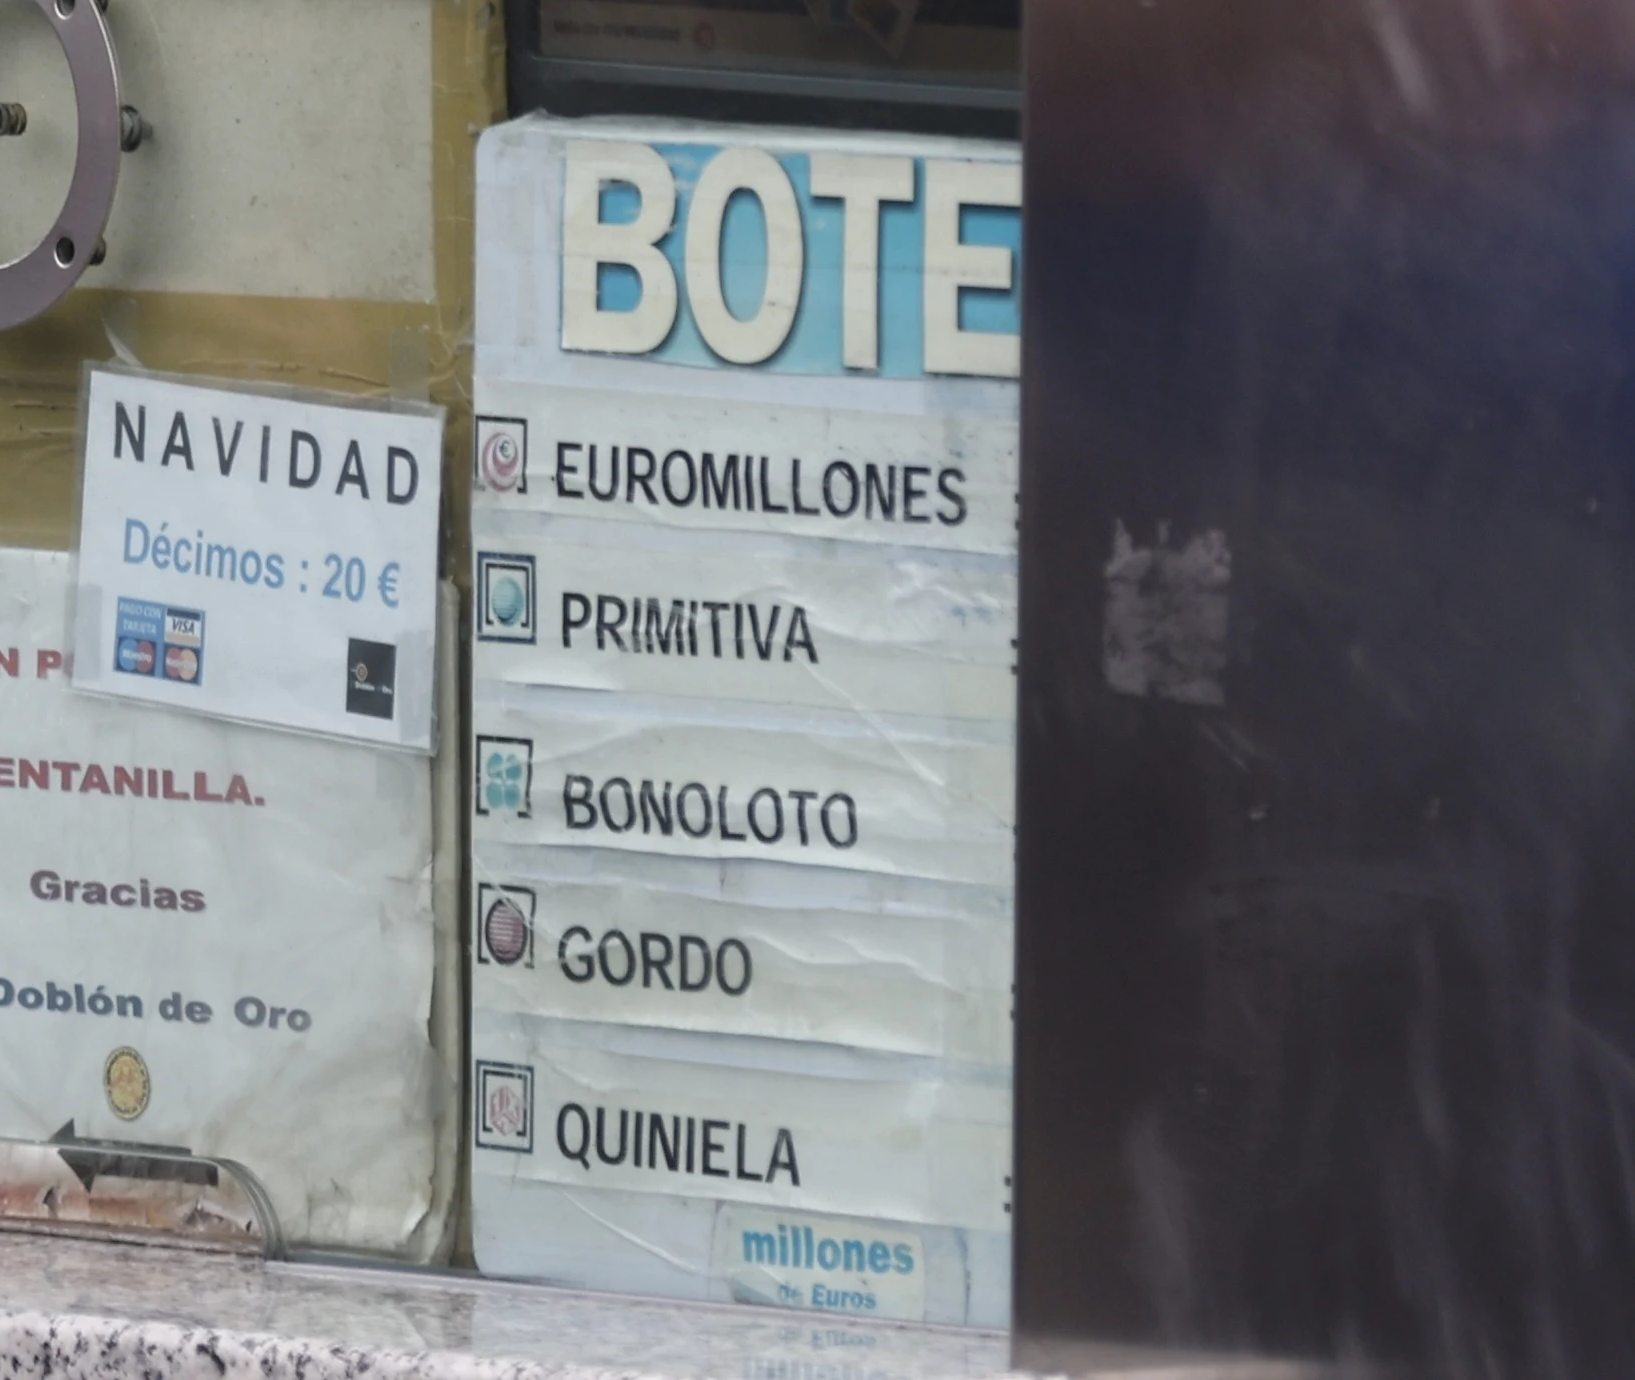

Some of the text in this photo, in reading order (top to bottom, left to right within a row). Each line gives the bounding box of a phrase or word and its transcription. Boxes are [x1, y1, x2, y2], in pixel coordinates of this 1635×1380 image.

[561, 139, 1023, 379] BOTE
[112, 400, 421, 507] NAVIDAD
[553, 441, 969, 528] EUROMILLONES
[122, 516, 284, 590] Décimos
[321, 551, 366, 601] 20
[377, 560, 402, 608] €
[172, 618, 195, 636] VISA
[561, 591, 821, 665] PRIMITIVA
[36, 649, 63, 680] P
[562, 773, 861, 851] BONOLOTO
[29, 869, 207, 913] Gracias
[556, 925, 754, 998] GORDO
[157, 991, 214, 1023] de
[232, 995, 313, 1034] Oro
[555, 1102, 803, 1188] QUINIELA
[742, 1223, 916, 1276] millones
[811, 1282, 878, 1310] Euros
